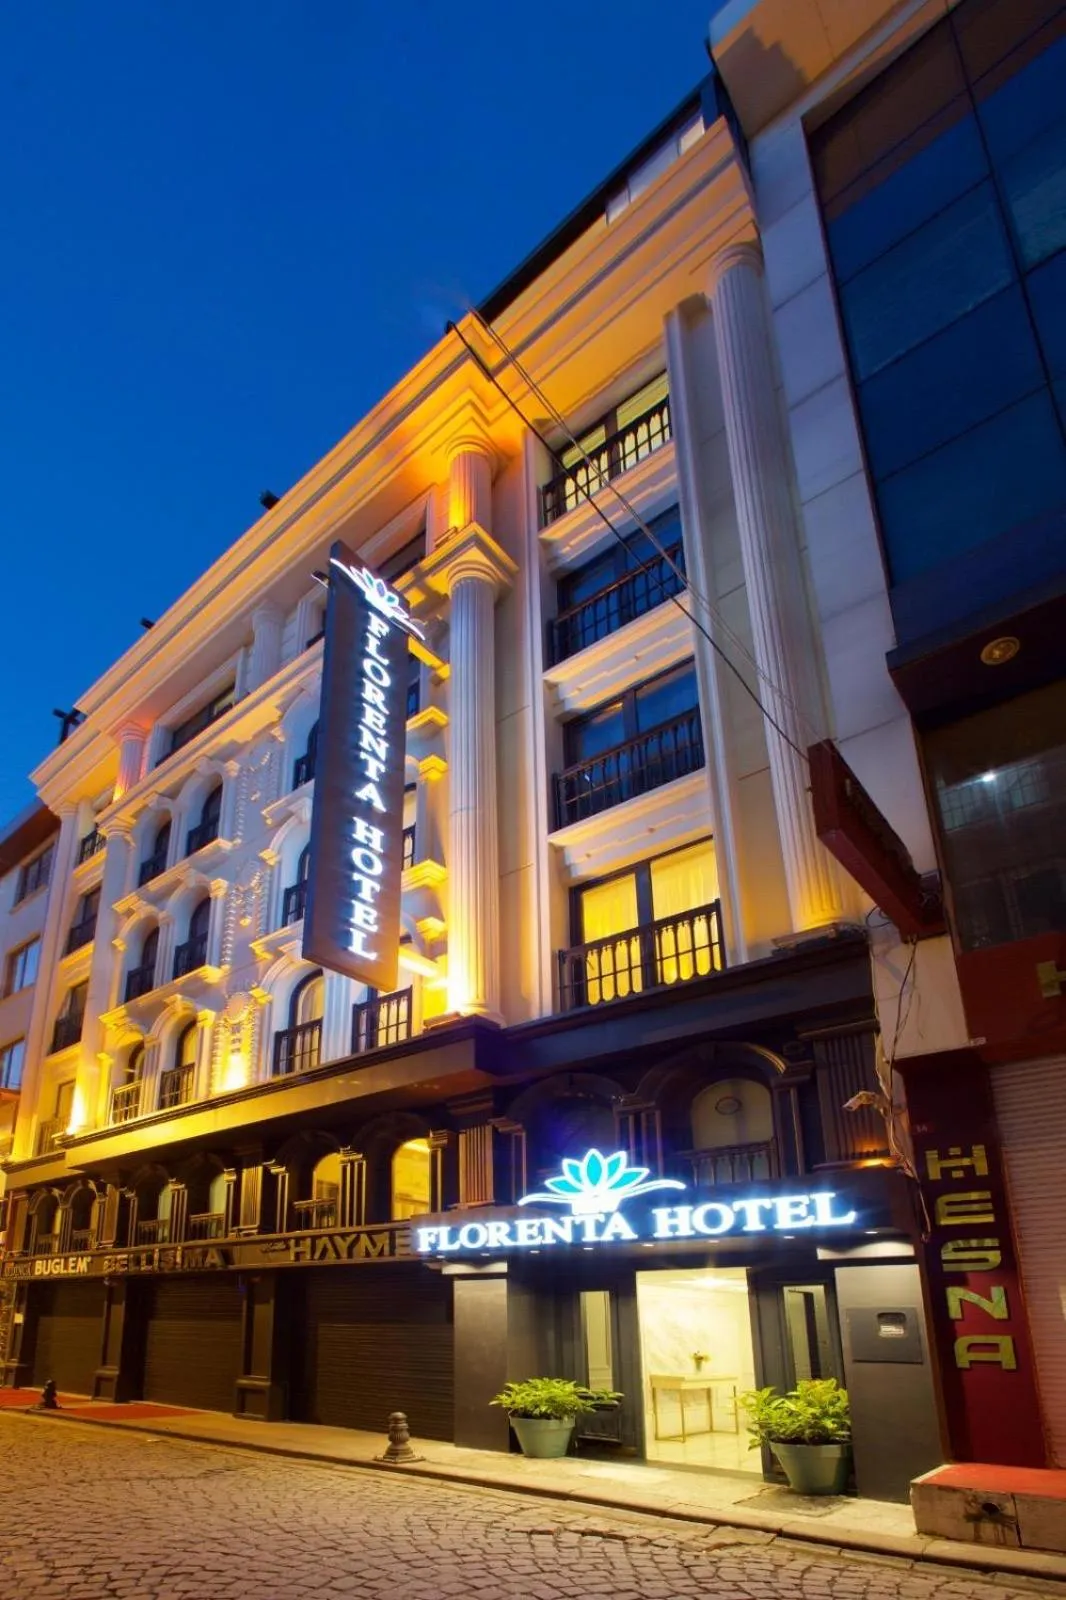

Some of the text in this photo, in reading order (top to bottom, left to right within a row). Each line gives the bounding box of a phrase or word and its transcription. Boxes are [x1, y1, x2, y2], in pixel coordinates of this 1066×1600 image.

[348, 611, 391, 961] FLORENTA HOTEL
[416, 1192, 857, 1252] FLORENTA HOTEL
